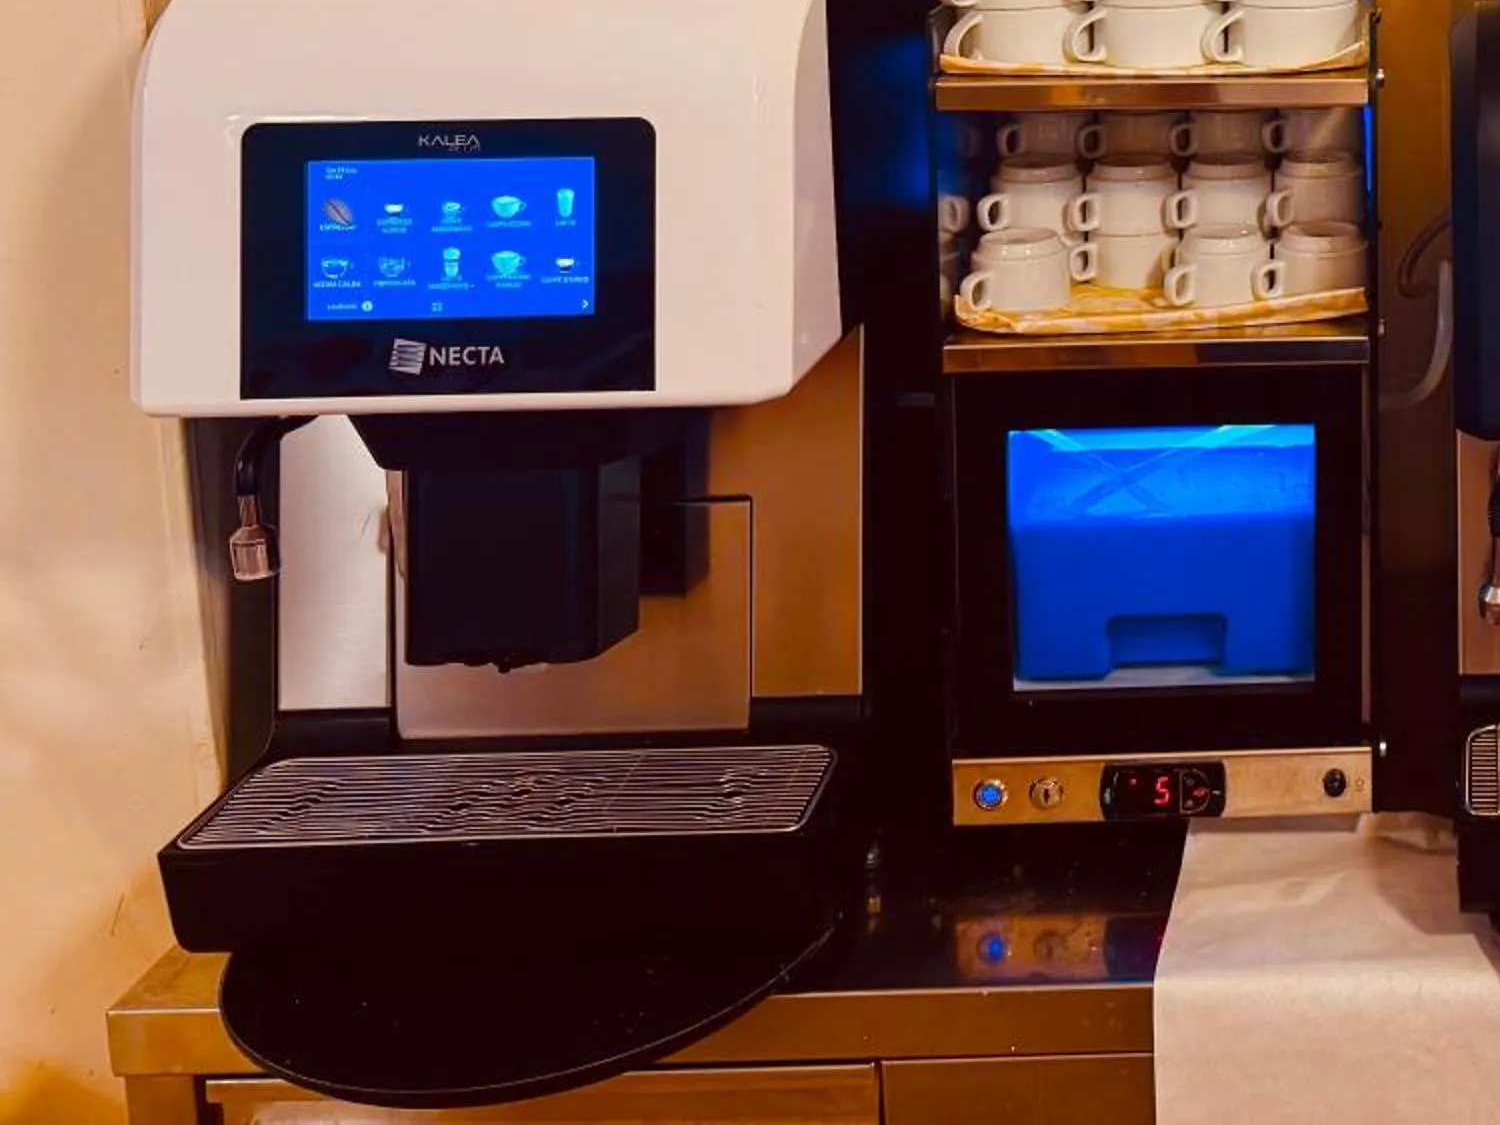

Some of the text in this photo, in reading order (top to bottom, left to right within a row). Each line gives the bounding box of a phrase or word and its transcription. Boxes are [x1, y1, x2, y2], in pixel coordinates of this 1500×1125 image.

[418, 134, 481, 149] KALEA
[429, 345, 505, 367] NECTA
[1153, 776, 1170, 806] 5
